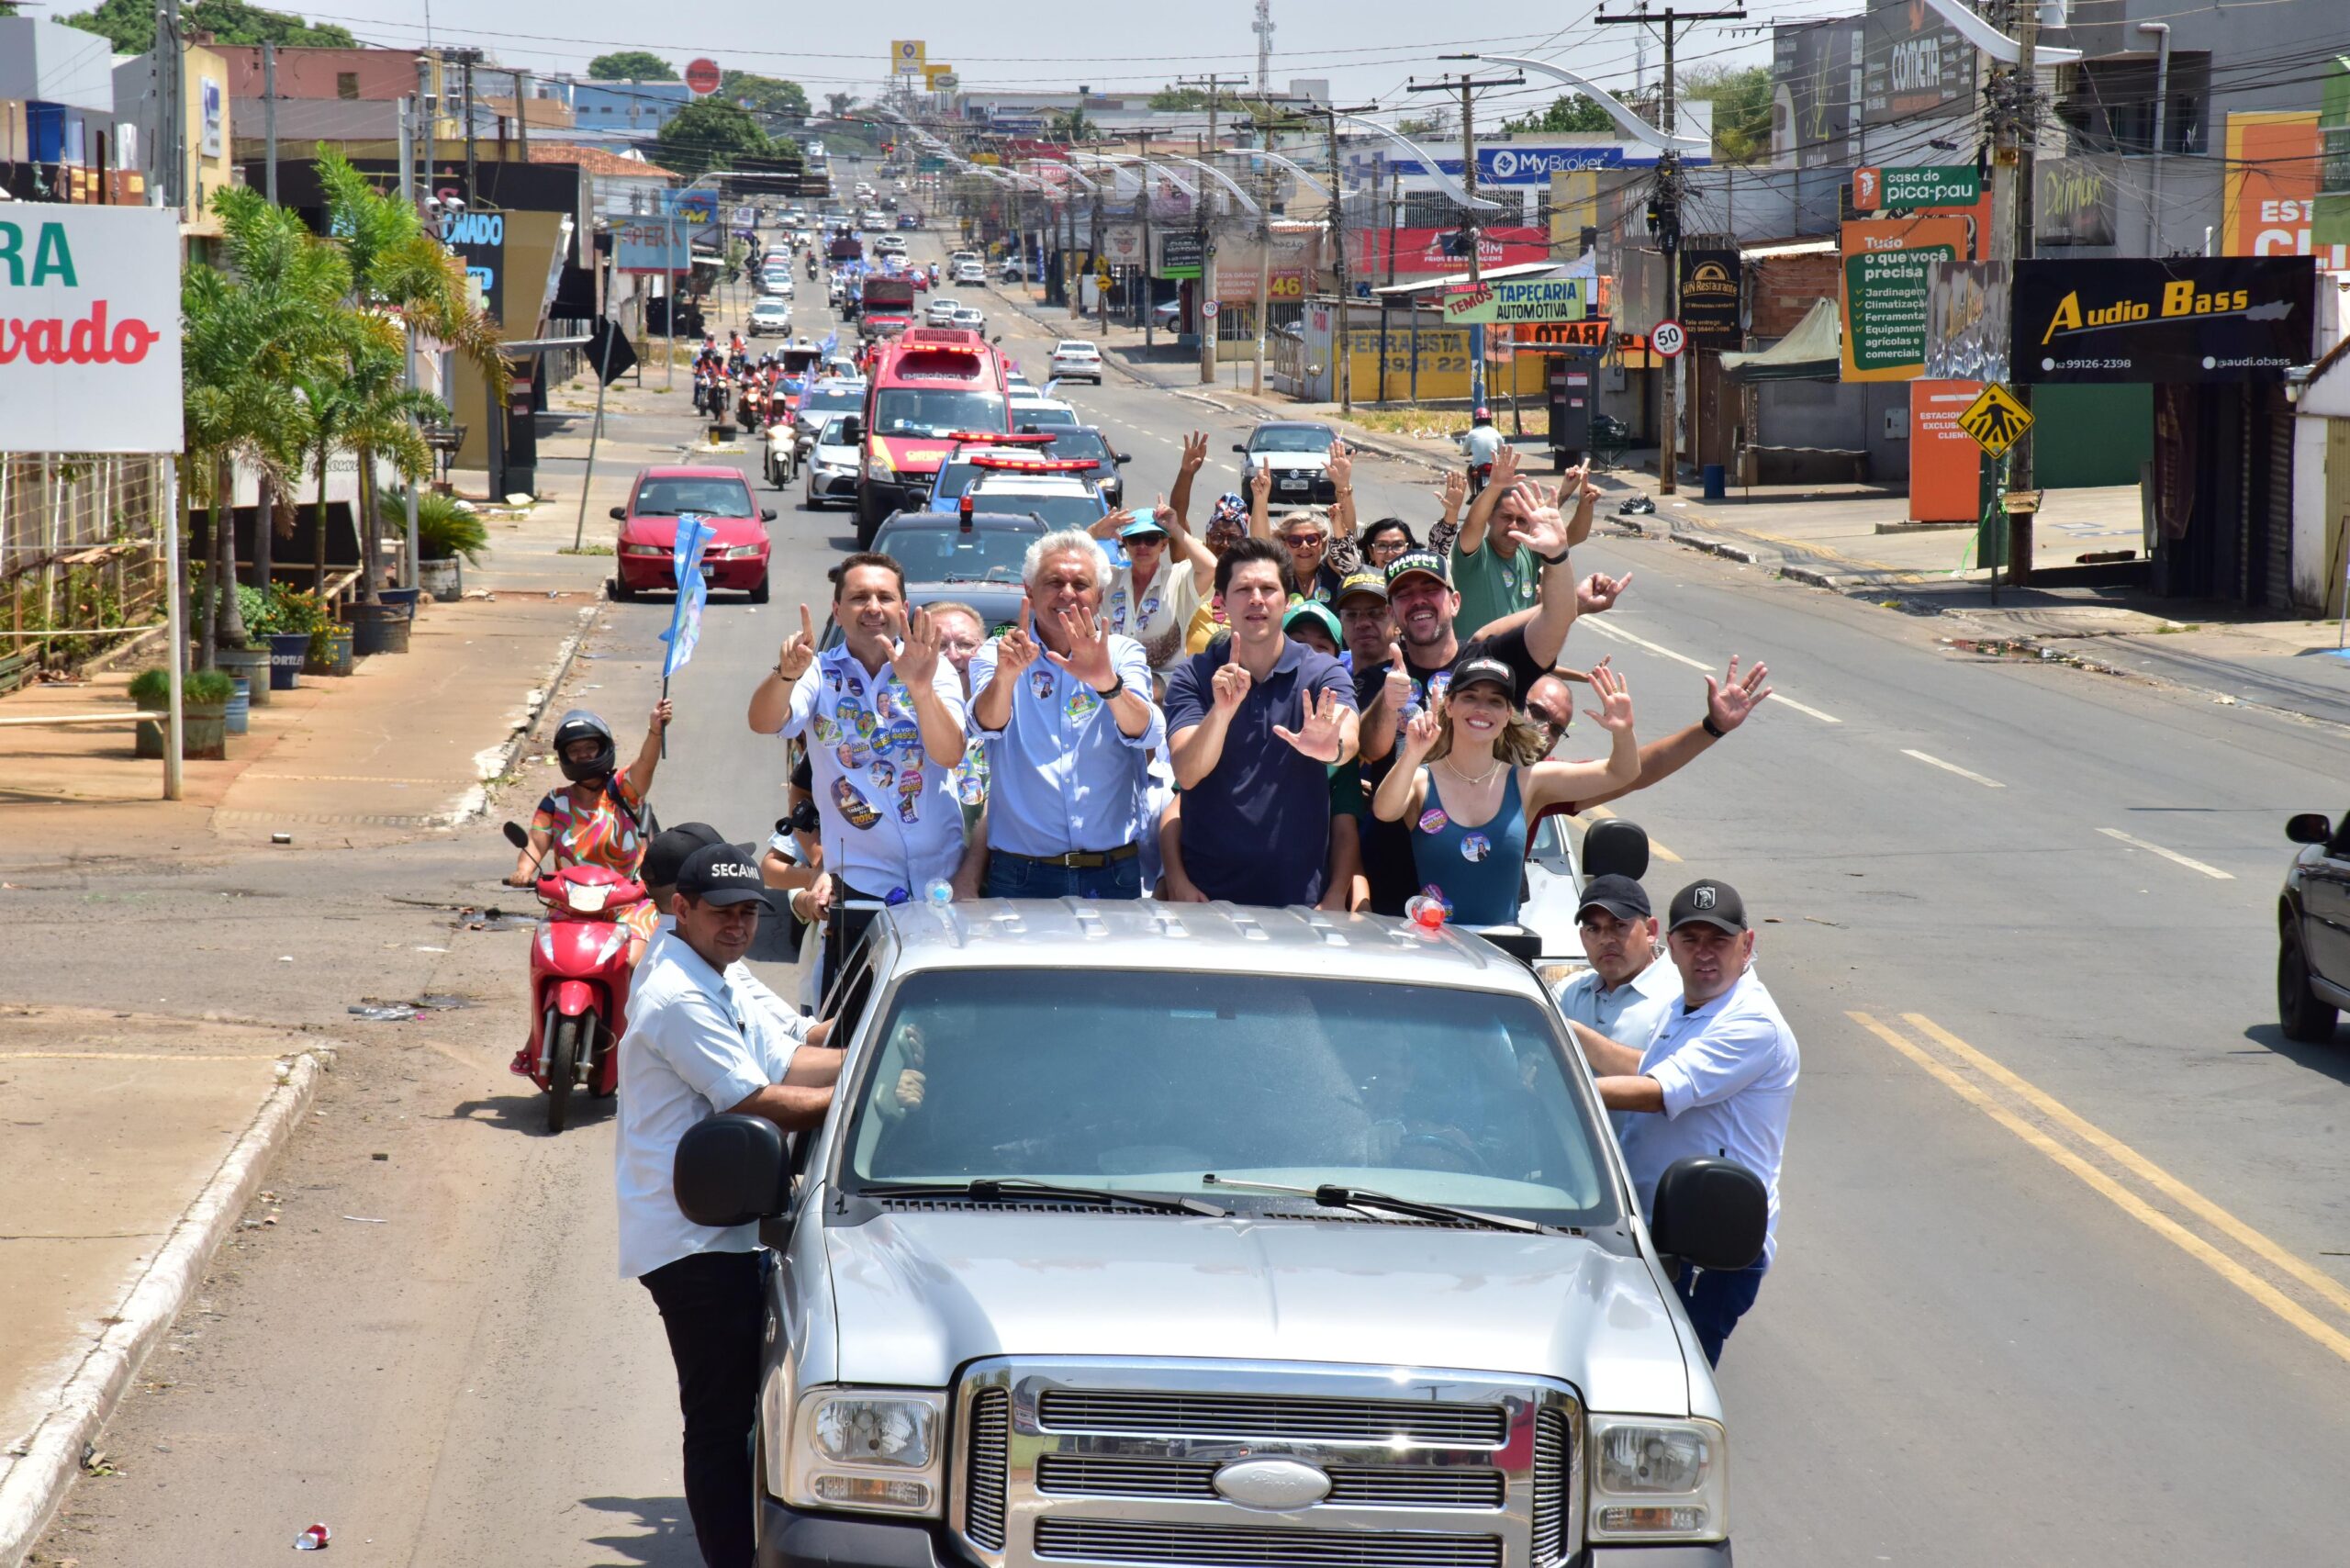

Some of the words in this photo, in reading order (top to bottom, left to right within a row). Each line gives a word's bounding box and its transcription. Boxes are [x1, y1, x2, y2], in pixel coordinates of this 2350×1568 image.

[1892, 37, 1940, 92] COMETA
[1887, 173, 1919, 184] casa
[1923, 169, 1940, 182] do
[1887, 184, 1973, 204] pica-pau
[2261, 200, 2314, 223] EST
[1864, 235, 1904, 250] Tudo
[1864, 254, 1874, 263] o
[1877, 252, 1908, 267] que
[1910, 249, 1948, 263] você
[1864, 265, 1923, 282] precisa
[1272, 277, 1302, 296] 46
[1499, 283, 1577, 302] TAPEÇARIA
[1865, 287, 1926, 297] Jardinagem
[1448, 290, 1494, 316] TEMOS
[1496, 303, 1568, 320] AUTOMOTIVA
[2041, 290, 2150, 345] Audio
[2161, 280, 2248, 317] Bass
[1658, 328, 1679, 346] 50
[1866, 325, 1927, 336] Equipament
[1865, 336, 1911, 348] agrícolas
[1865, 348, 1920, 358] comerciais
[2066, 359, 2132, 369] 99126-2398
[2217, 356, 2291, 368] @audi.obass
[902, 371, 961, 380] EMERGÊNCIA
[1919, 411, 1963, 420] ESTACION
[1388, 554, 1438, 571] LEANDRO
